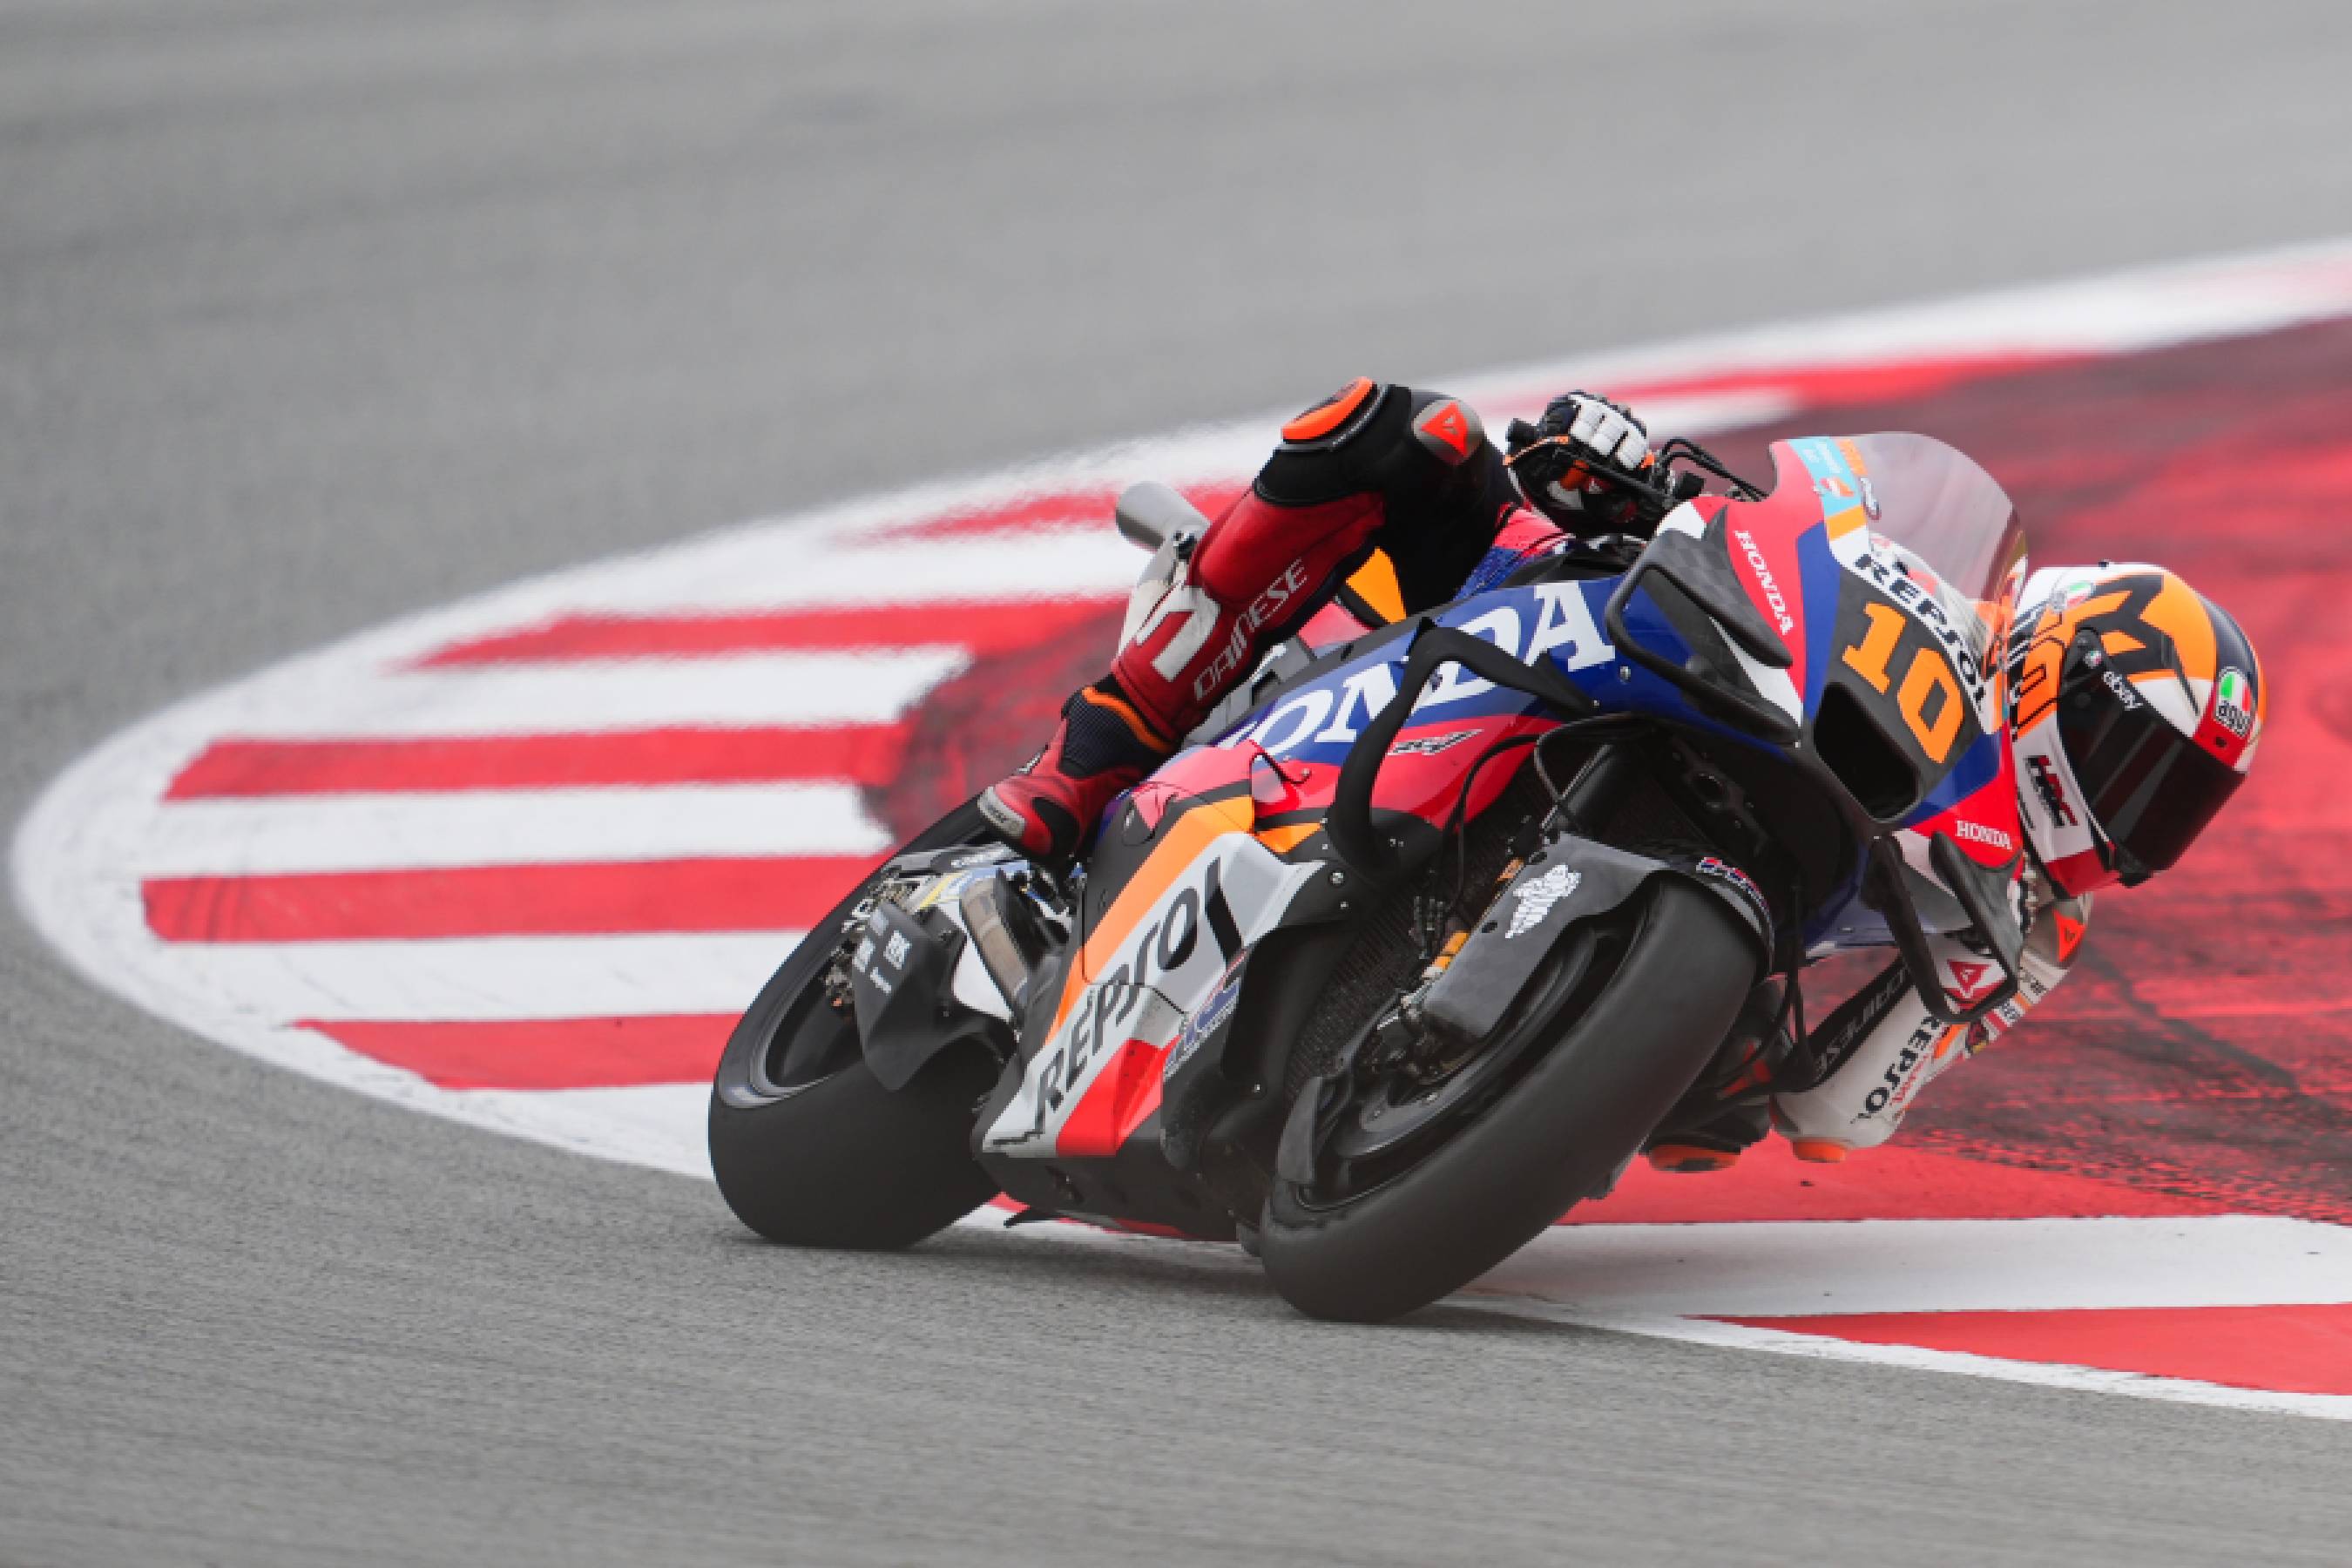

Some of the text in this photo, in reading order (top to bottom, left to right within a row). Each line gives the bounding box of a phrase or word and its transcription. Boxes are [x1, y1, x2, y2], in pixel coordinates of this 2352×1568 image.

[1734, 529, 1795, 636] HONDA
[1855, 553, 1985, 713] REPSOL
[1842, 602, 1965, 764] 10
[2103, 670, 2145, 711] ebay
[1955, 820, 2013, 850] HONDA
[2024, 754, 2078, 827] HRC
[1035, 856, 1244, 1132] REPSOL
